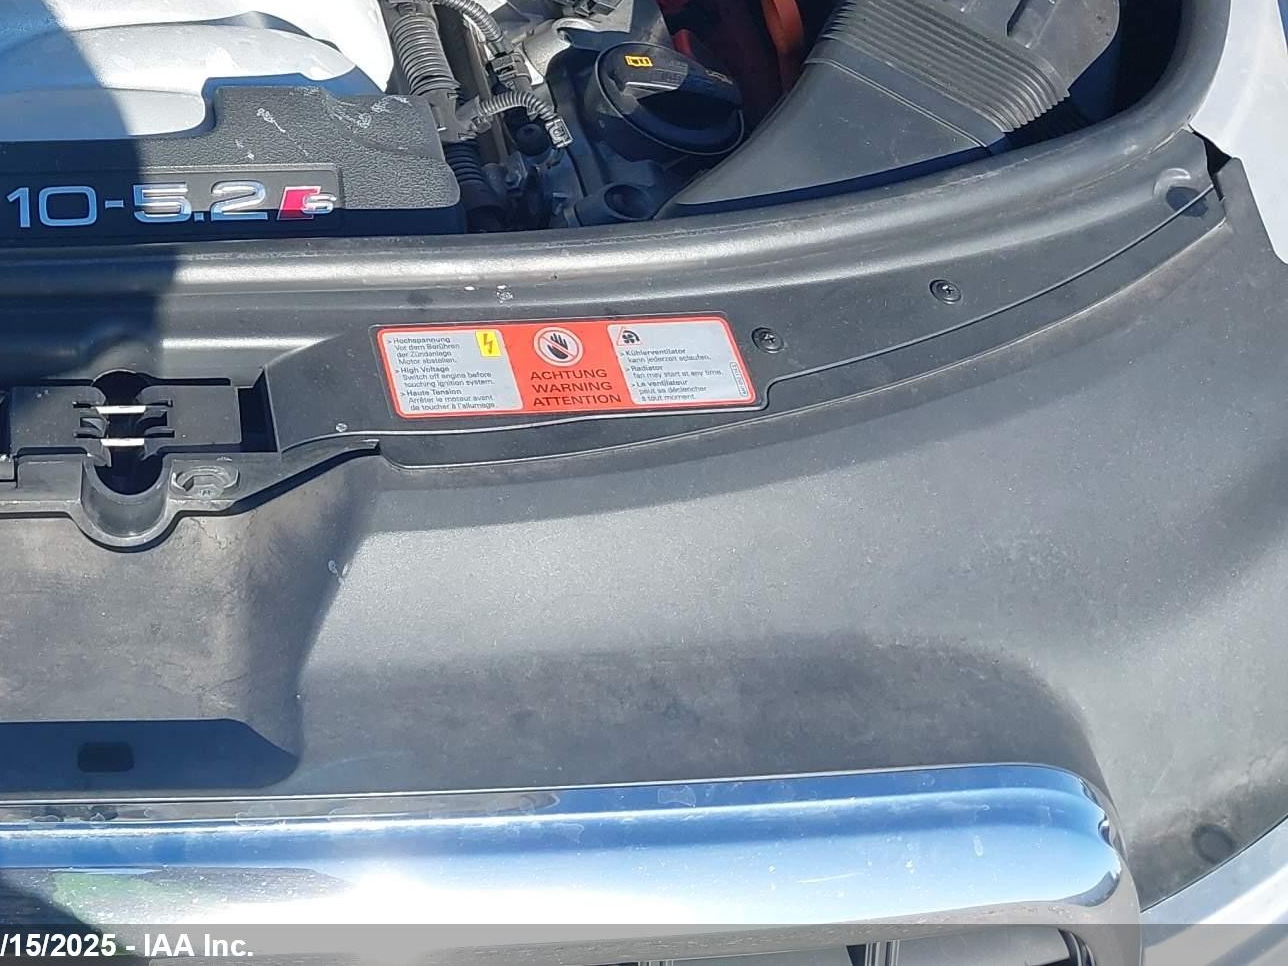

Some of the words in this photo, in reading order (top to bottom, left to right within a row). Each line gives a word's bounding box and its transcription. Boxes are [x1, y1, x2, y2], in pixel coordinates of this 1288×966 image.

[410, 350, 452, 358] Zündanlage
[626, 348, 686, 356] Kühlerventilator
[530, 369, 608, 380] ACHTUNG
[646, 372, 664, 380] may
[404, 380, 436, 388] touching
[532, 381, 612, 393] WARNING
[409, 396, 434, 404] Arrêter
[533, 394, 622, 406] ATTENTION
[421, 402, 450, 410] toucher
